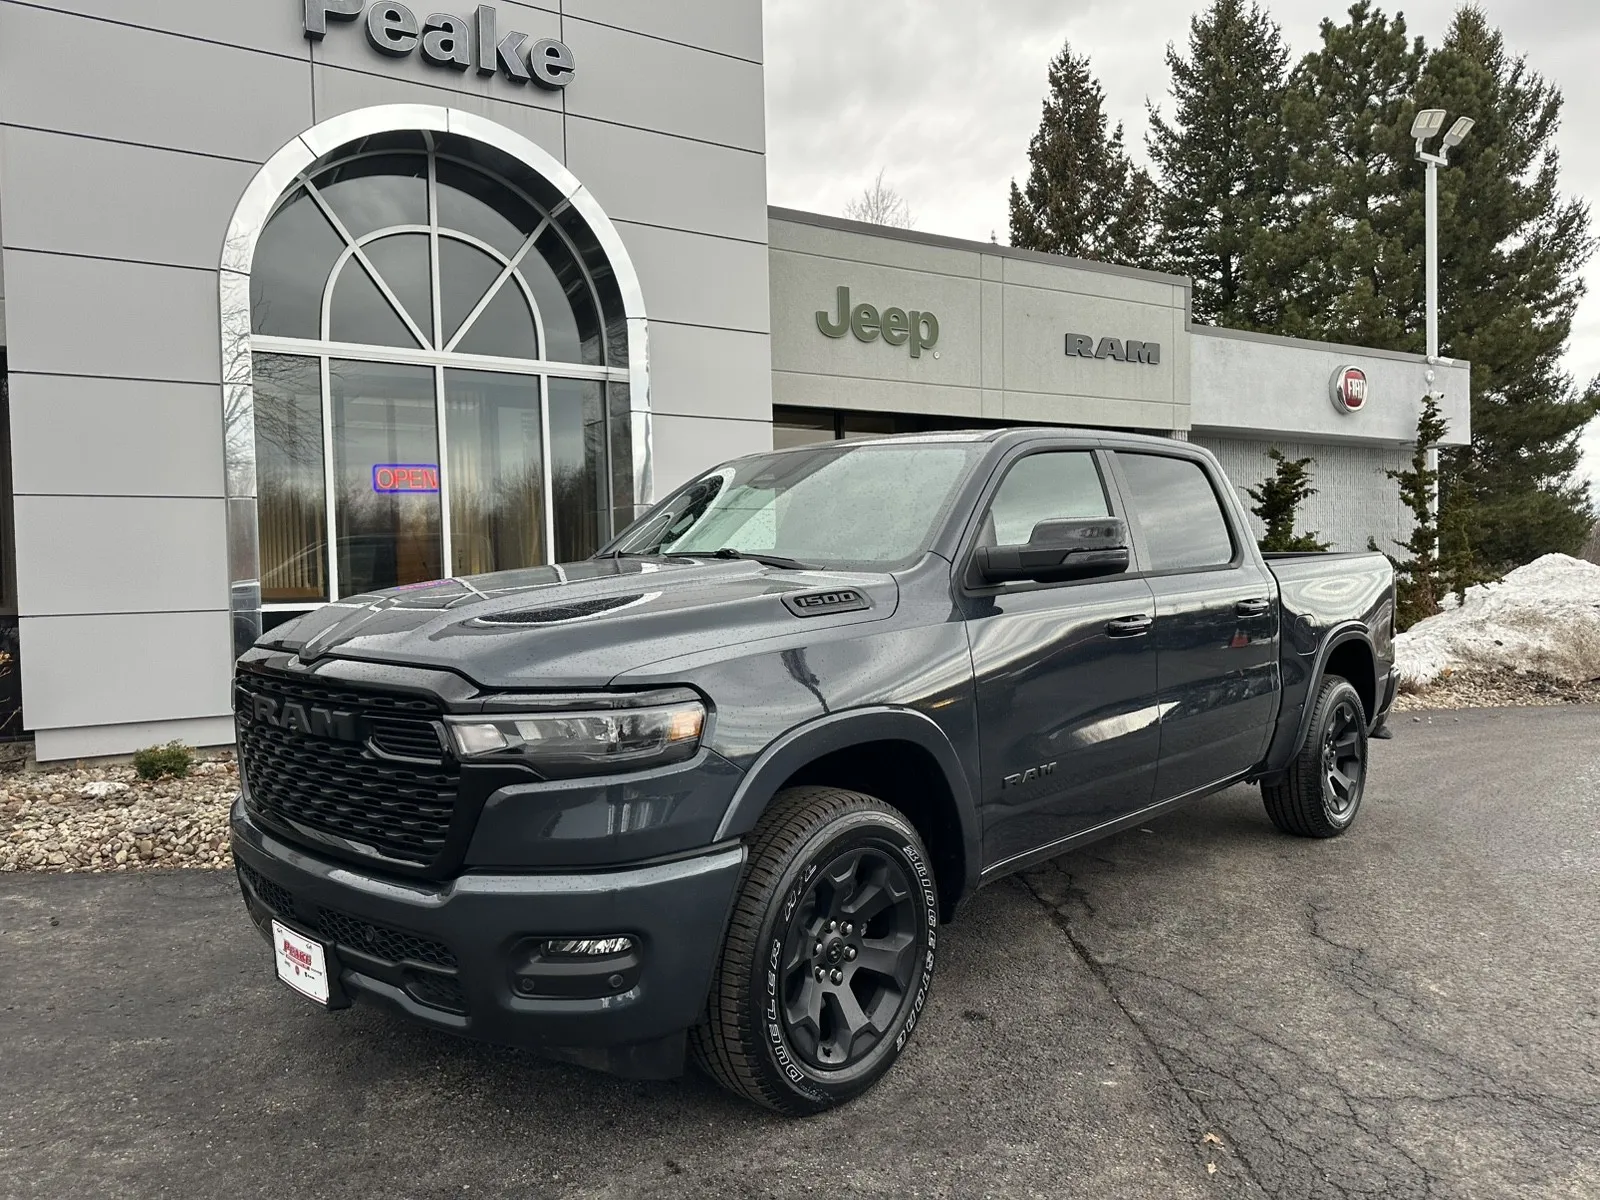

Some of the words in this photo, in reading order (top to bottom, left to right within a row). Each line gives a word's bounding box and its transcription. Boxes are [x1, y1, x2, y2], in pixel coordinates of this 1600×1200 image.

[815, 285, 940, 358] Jeep
[1064, 332, 1161, 365] RAM
[1347, 378, 1365, 399] FIAT
[376, 468, 437, 490] OPEN
[798, 592, 856, 607] 1500
[253, 692, 357, 741] RAM
[1002, 761, 1057, 789] RAM
[897, 844, 937, 1052] BRIDGESTONE
[767, 938, 804, 1083] DUELER
